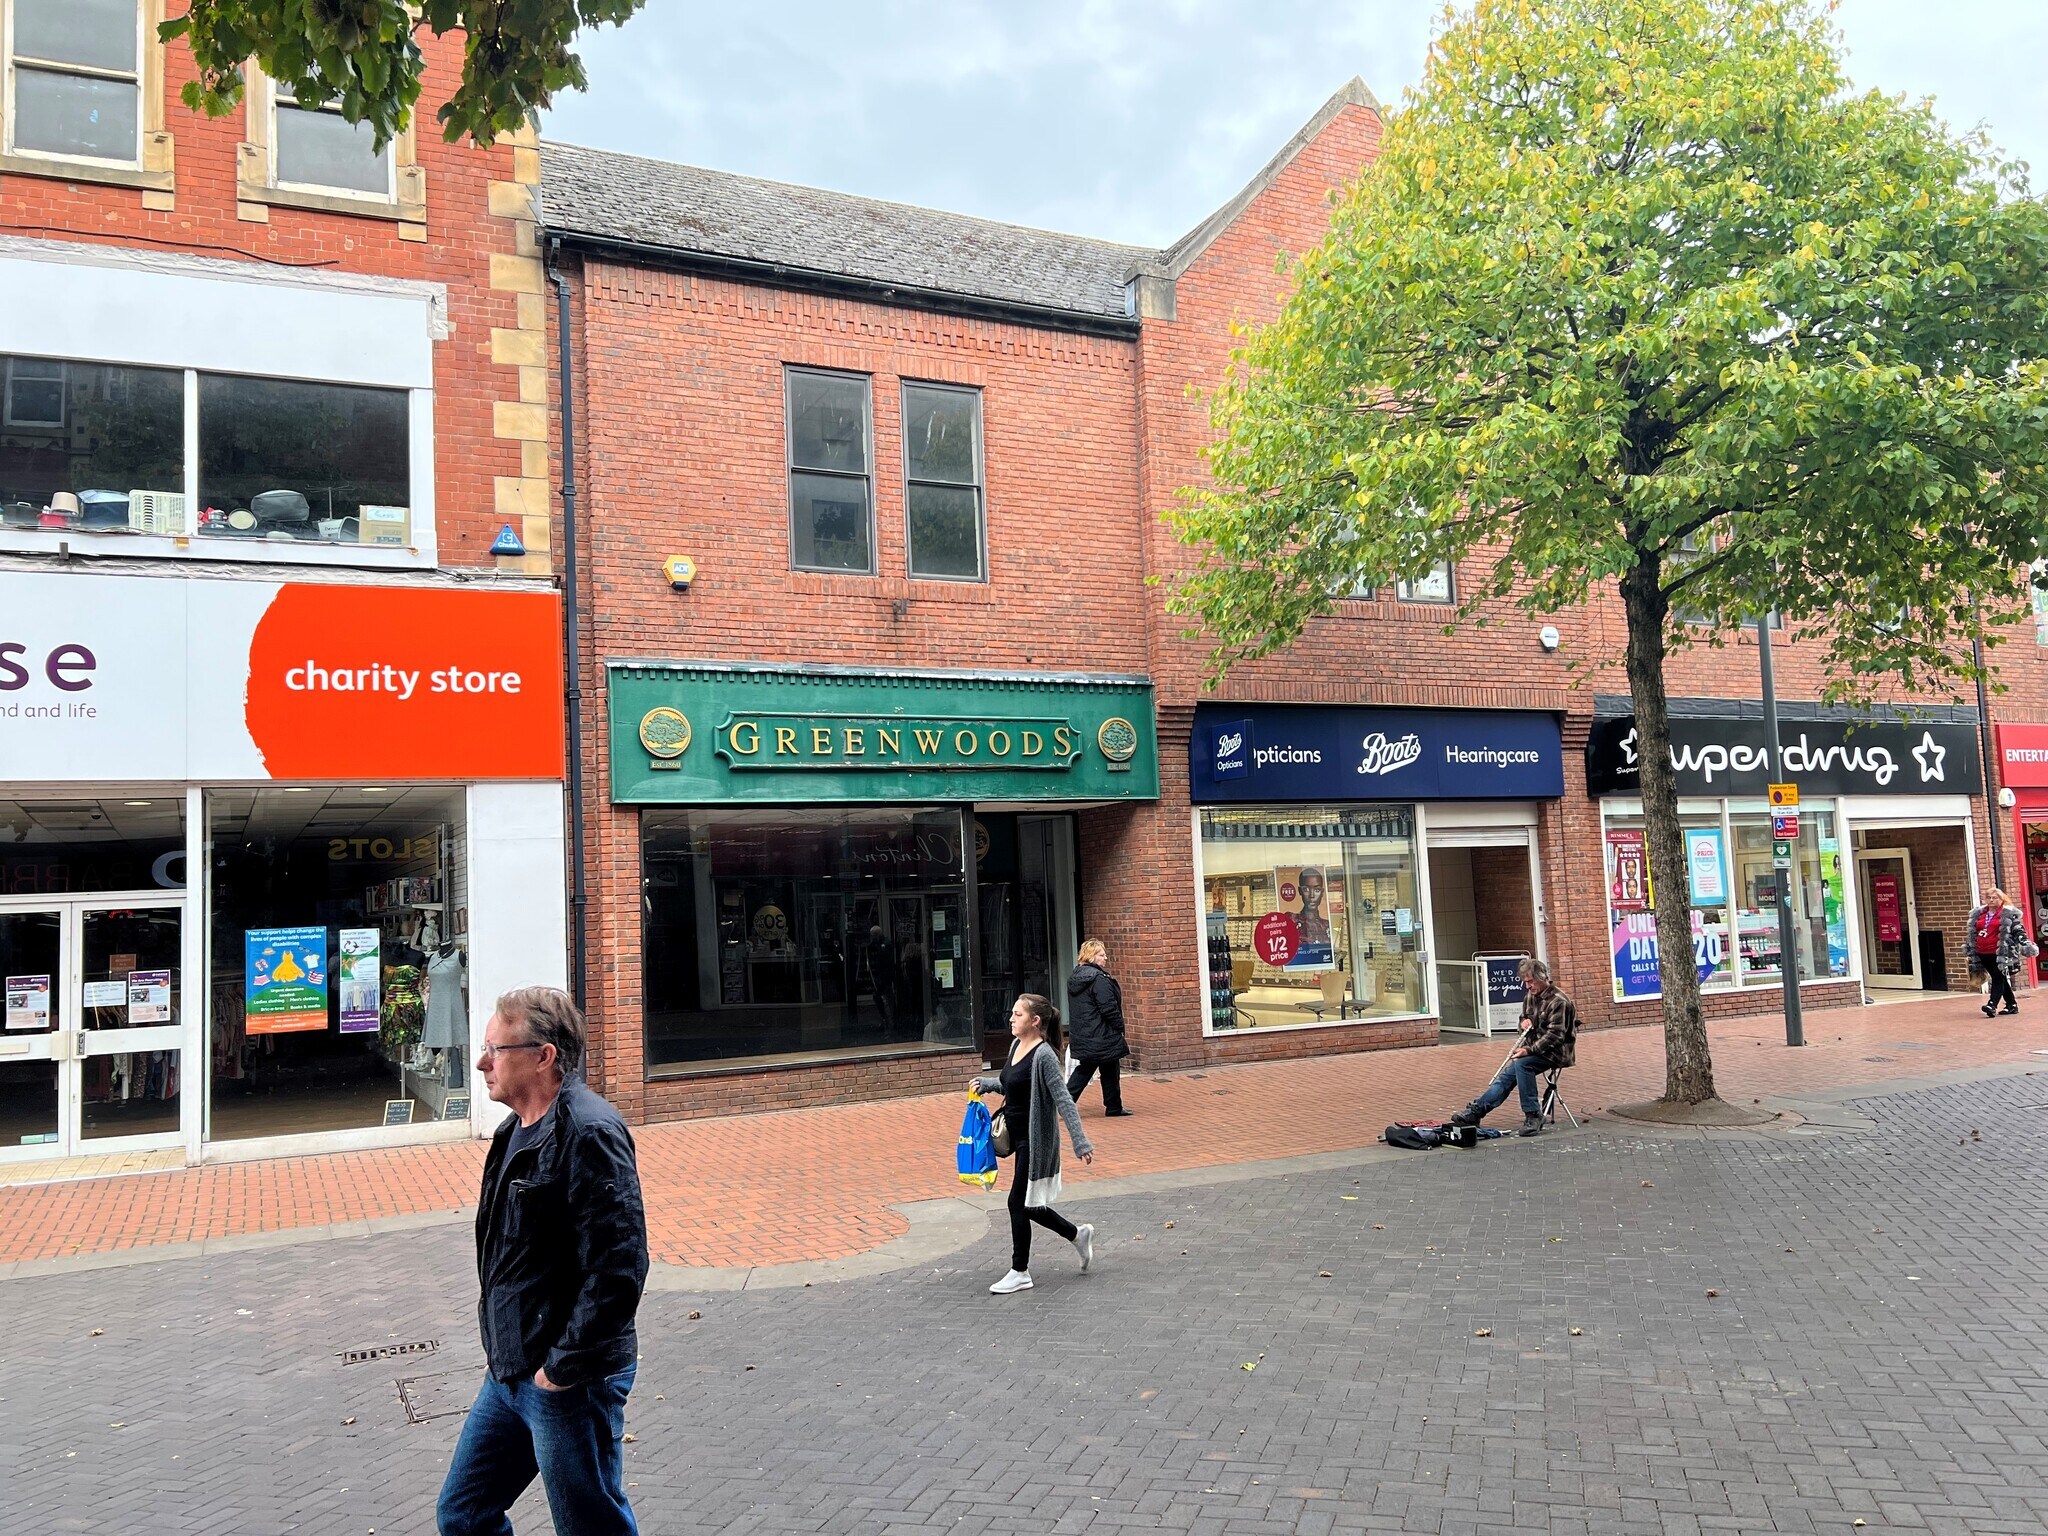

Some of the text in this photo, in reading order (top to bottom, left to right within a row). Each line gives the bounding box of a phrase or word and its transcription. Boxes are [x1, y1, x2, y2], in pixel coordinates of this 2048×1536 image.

[498, 541, 518, 549] Chubb
[674, 563, 689, 574] ADT
[285, 660, 521, 700] charity store
[25, 703, 60, 718] and
[69, 703, 97, 718] life
[729, 721, 1072, 757] GREENWOODS
[1217, 733, 1242, 758] Boots
[1253, 745, 1322, 769] pticians
[1357, 732, 1422, 776] Boots
[1446, 745, 1539, 768] Hearingcare
[1217, 760, 1243, 772] Opticians
[1263, 921, 1287, 930] additional
[1267, 936, 1288, 953] 1/2
[1629, 935, 1659, 961] DAT
[1270, 952, 1289, 962] price
[1631, 963, 1649, 973] CALLS
[1632, 975, 1661, 984] GET YOU
[1502, 980, 1524, 997] you!
